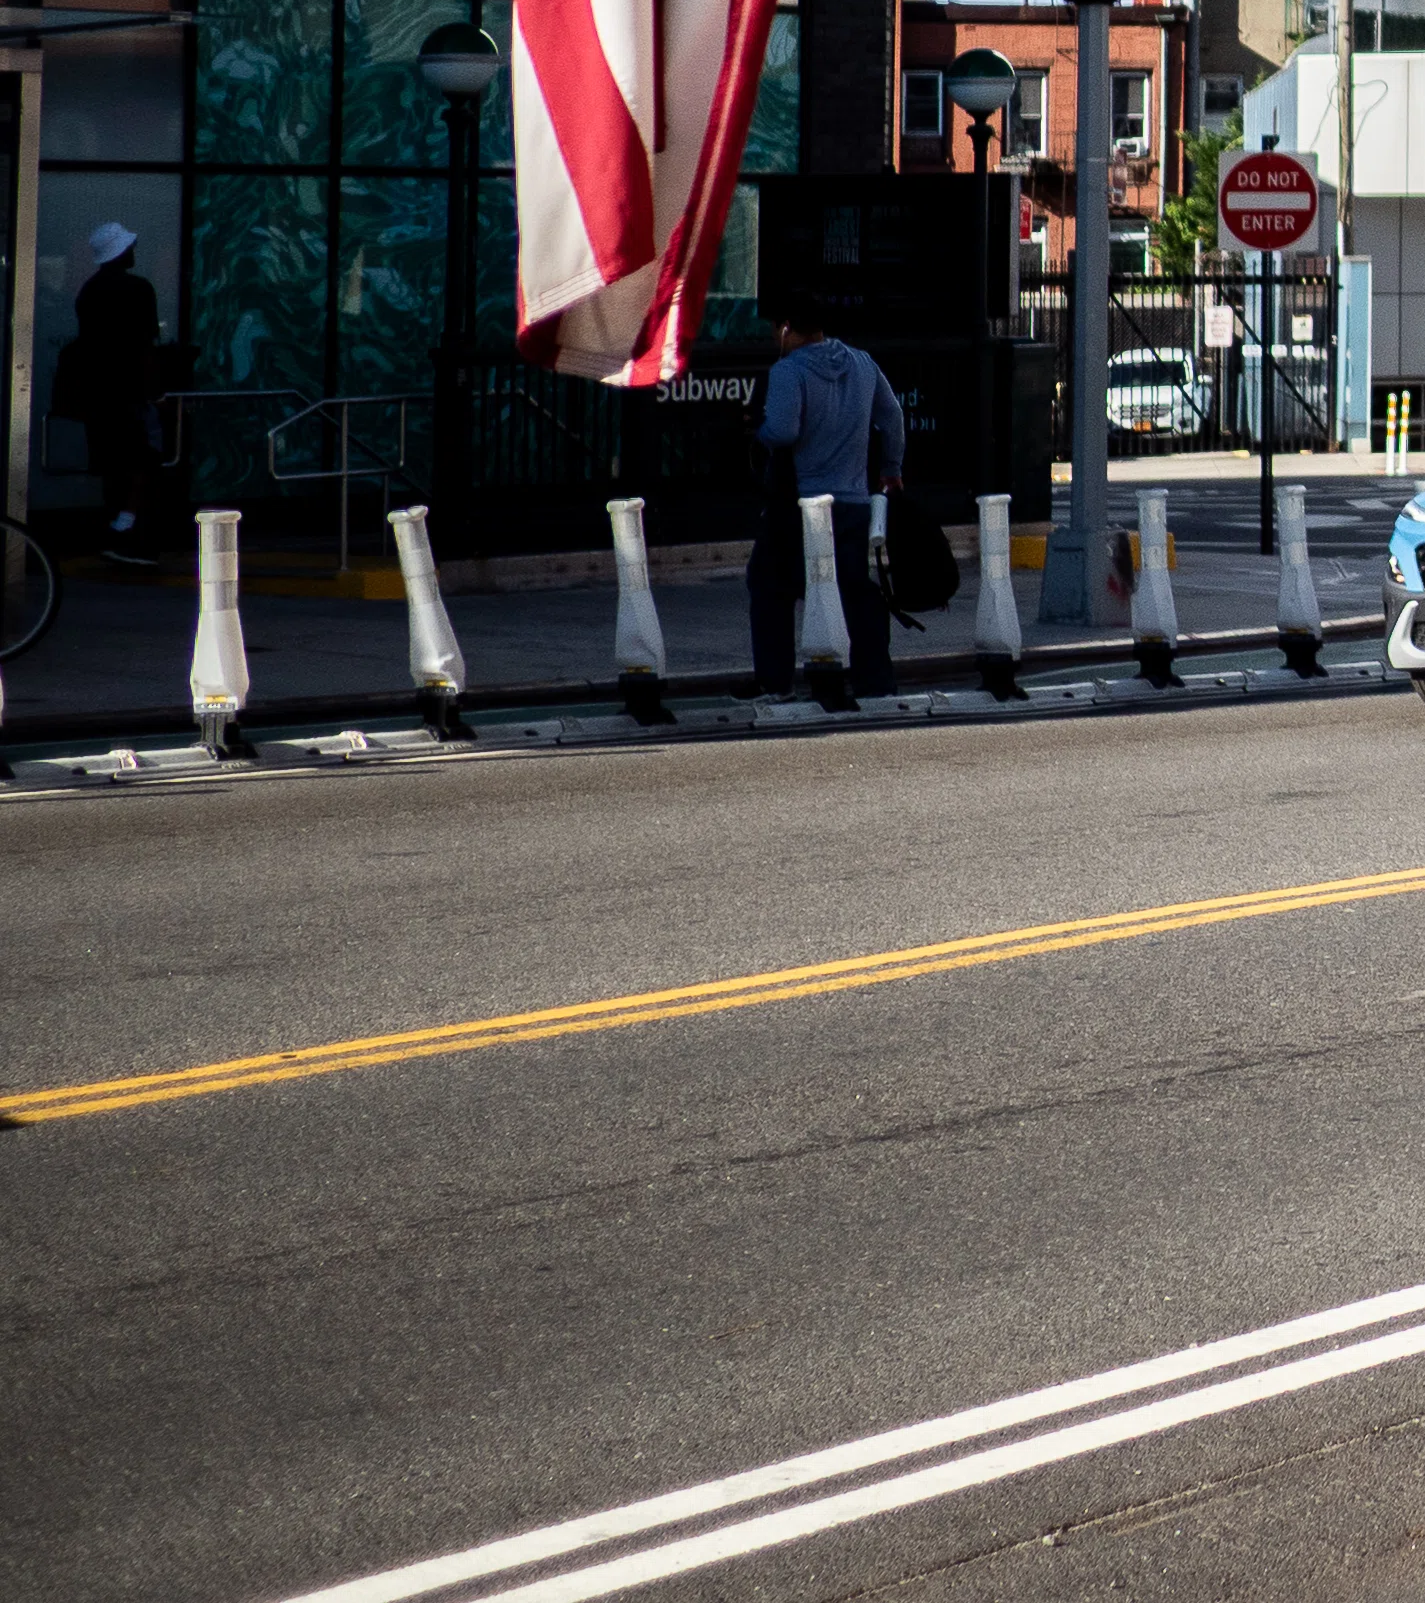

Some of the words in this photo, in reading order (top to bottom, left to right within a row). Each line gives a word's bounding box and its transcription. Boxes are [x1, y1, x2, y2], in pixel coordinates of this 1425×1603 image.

[1237, 171, 1260, 188] DO
[1267, 171, 1300, 188] NOT
[1241, 214, 1295, 232] ENTER
[656, 372, 756, 406] Subway
